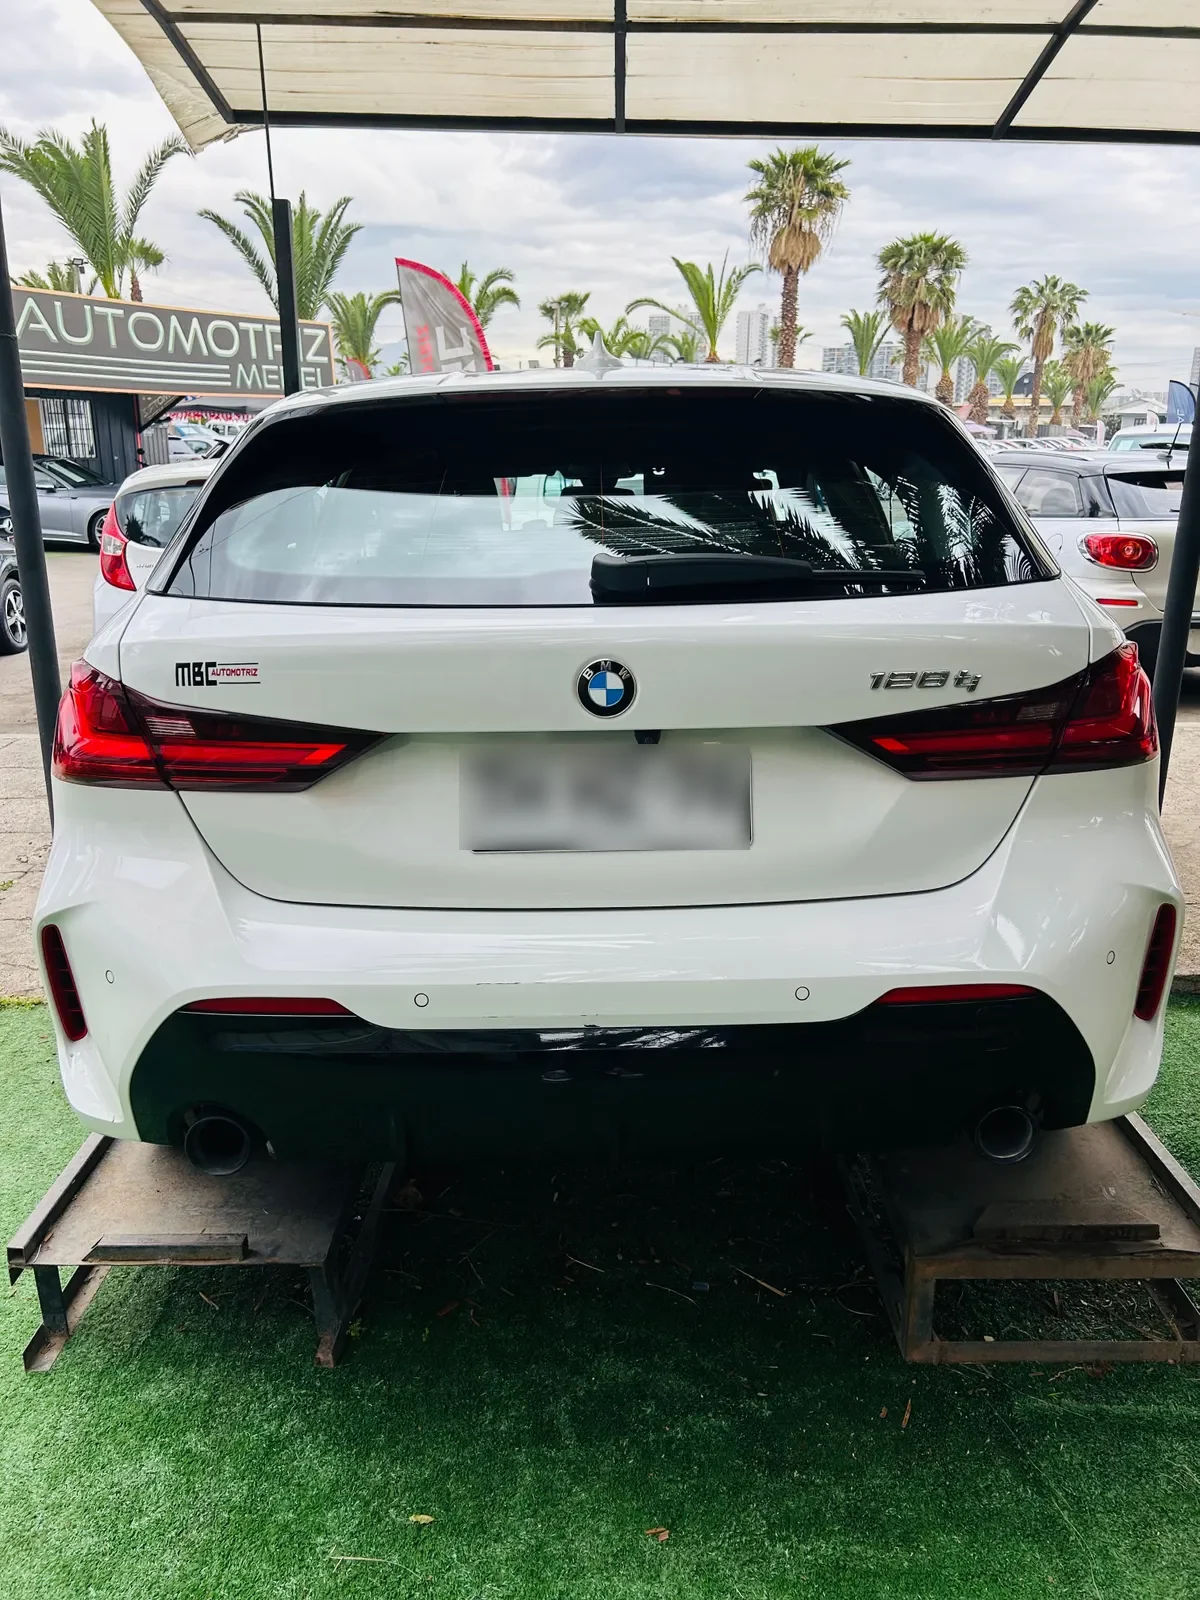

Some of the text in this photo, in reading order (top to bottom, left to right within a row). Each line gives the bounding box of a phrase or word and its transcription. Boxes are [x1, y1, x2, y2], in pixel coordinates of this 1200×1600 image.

[175, 661, 259, 687] MBC AUTOMOTRIZ
[582, 660, 631, 681] BMW
